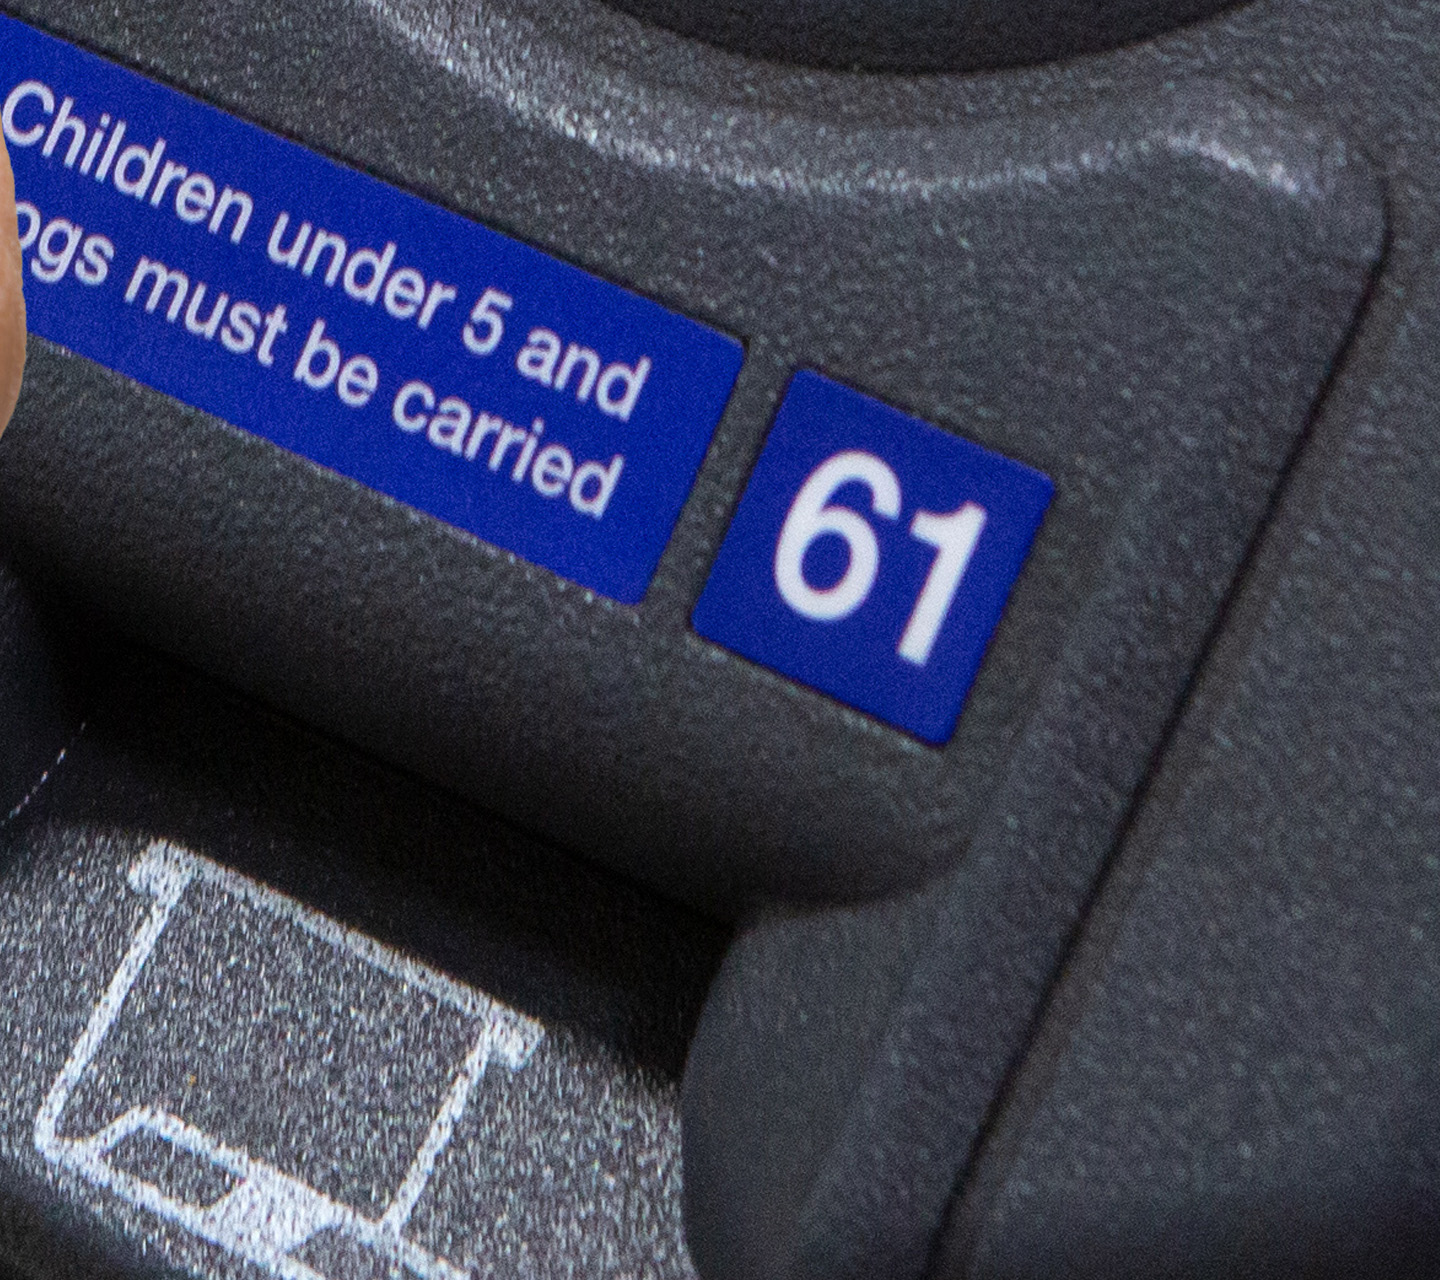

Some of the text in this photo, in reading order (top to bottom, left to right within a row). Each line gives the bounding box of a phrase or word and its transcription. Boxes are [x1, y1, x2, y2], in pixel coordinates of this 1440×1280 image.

[0, 79, 651, 423] Children under 5 and
[15, 200, 623, 519] ogs must be carried
[773, 451, 989, 667] 61
